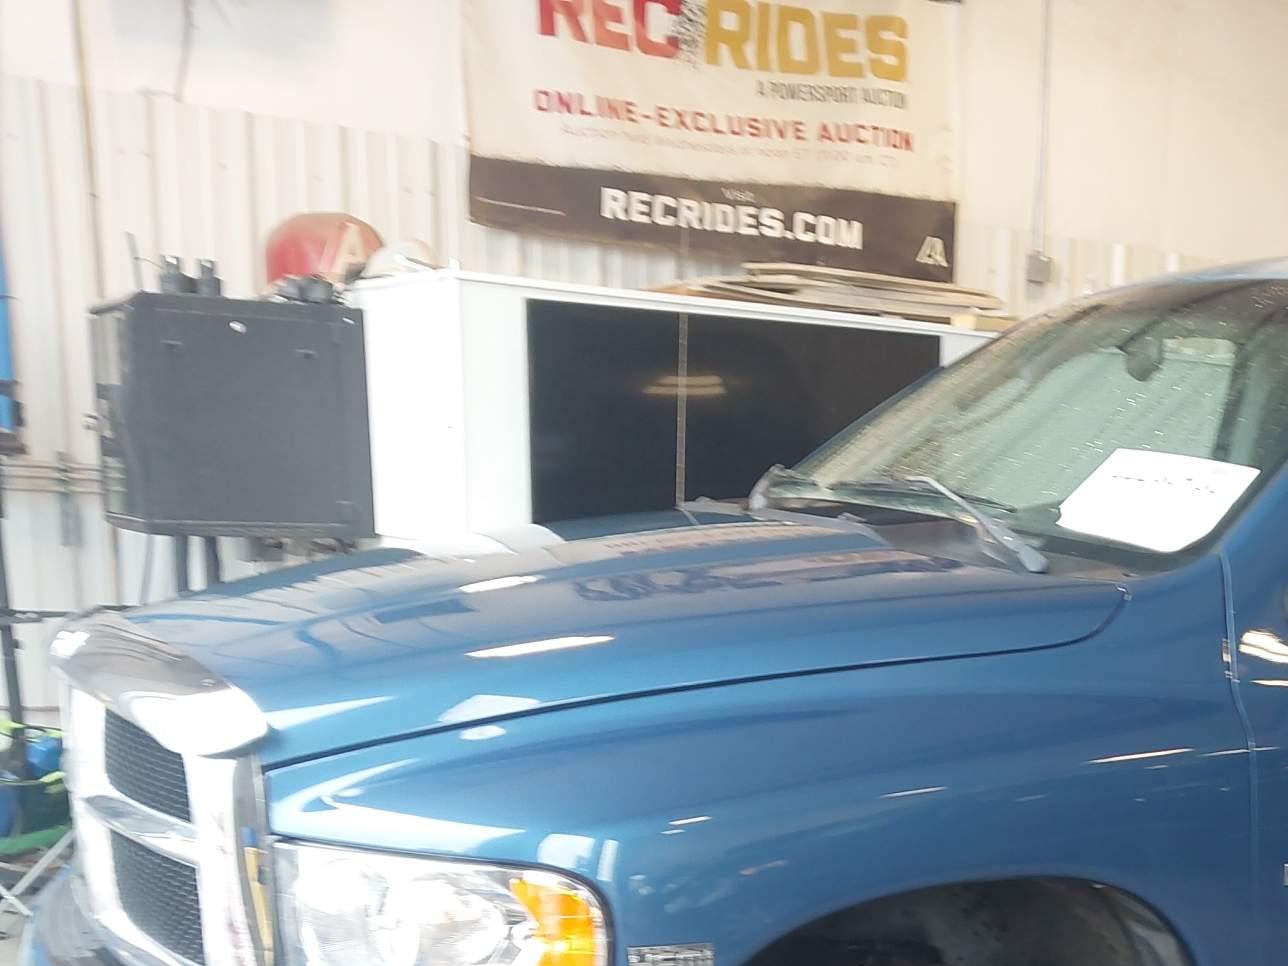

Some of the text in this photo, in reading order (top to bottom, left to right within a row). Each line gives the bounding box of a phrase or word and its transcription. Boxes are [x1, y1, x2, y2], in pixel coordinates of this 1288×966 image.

[538, 0, 908, 82] REC RIDES
[533, 88, 807, 142] ONLINE-EXCLUSIVE
[818, 121, 914, 152] AUCTION
[600, 186, 863, 249] RECRIDES.COM
